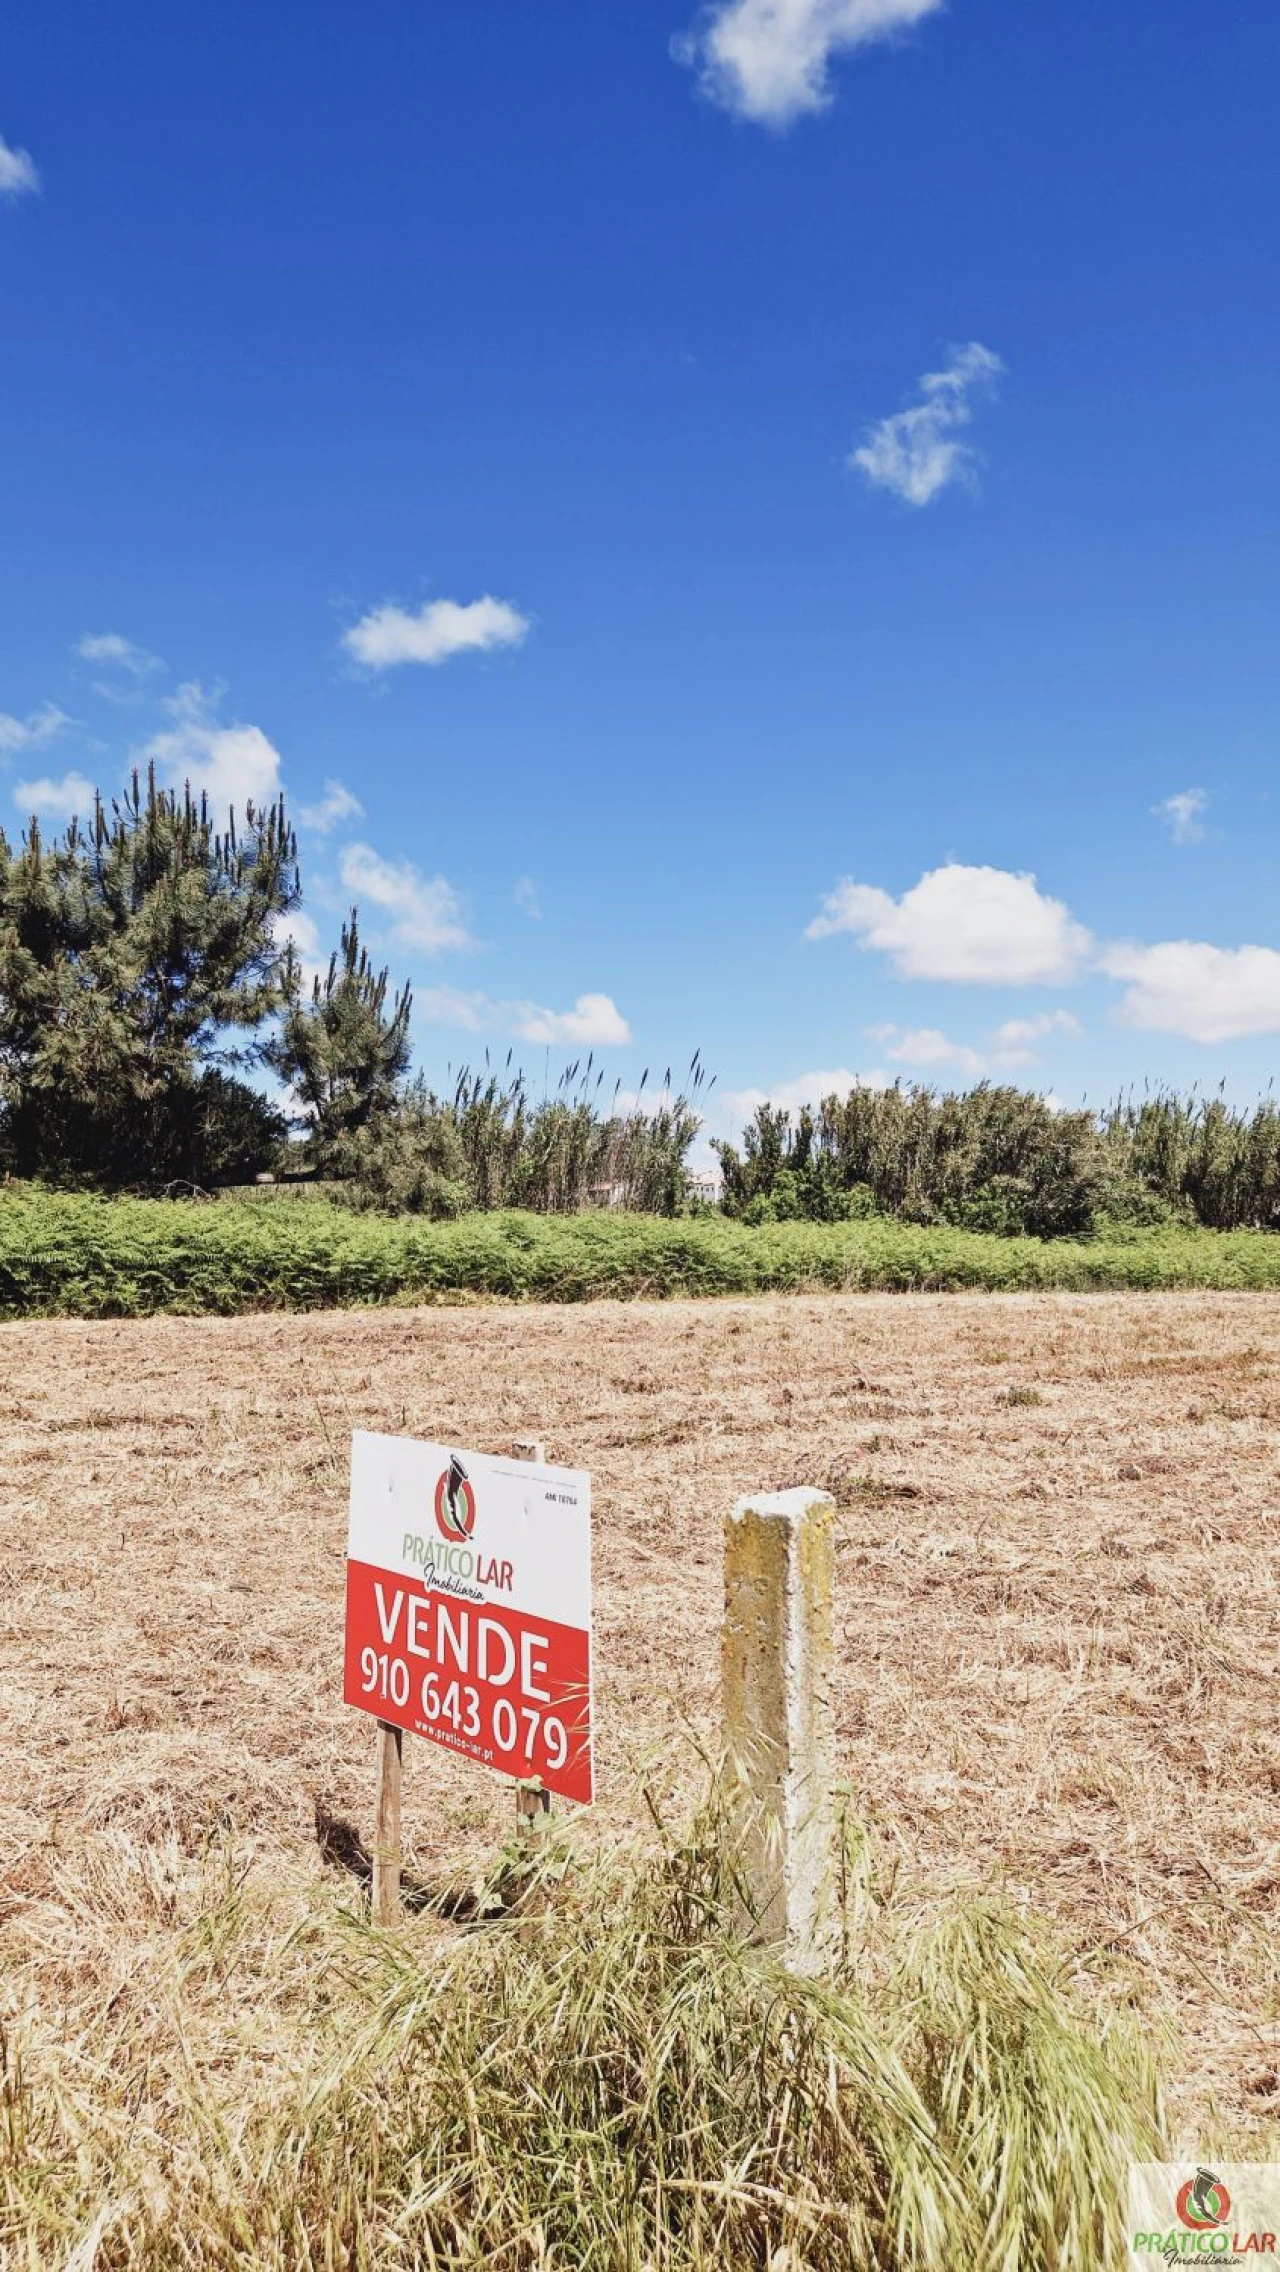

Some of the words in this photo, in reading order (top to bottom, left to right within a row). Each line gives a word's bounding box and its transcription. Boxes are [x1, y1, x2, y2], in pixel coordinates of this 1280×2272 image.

[402, 1533, 474, 1579] PRÁTICO
[476, 1554, 514, 1593] LAR
[373, 1581, 552, 1704] VENDE
[360, 1646, 410, 1707] 910
[420, 1670, 481, 1738] 643
[492, 1701, 568, 1770] 079
[414, 1717, 494, 1761] www.pratico-lar.pt
